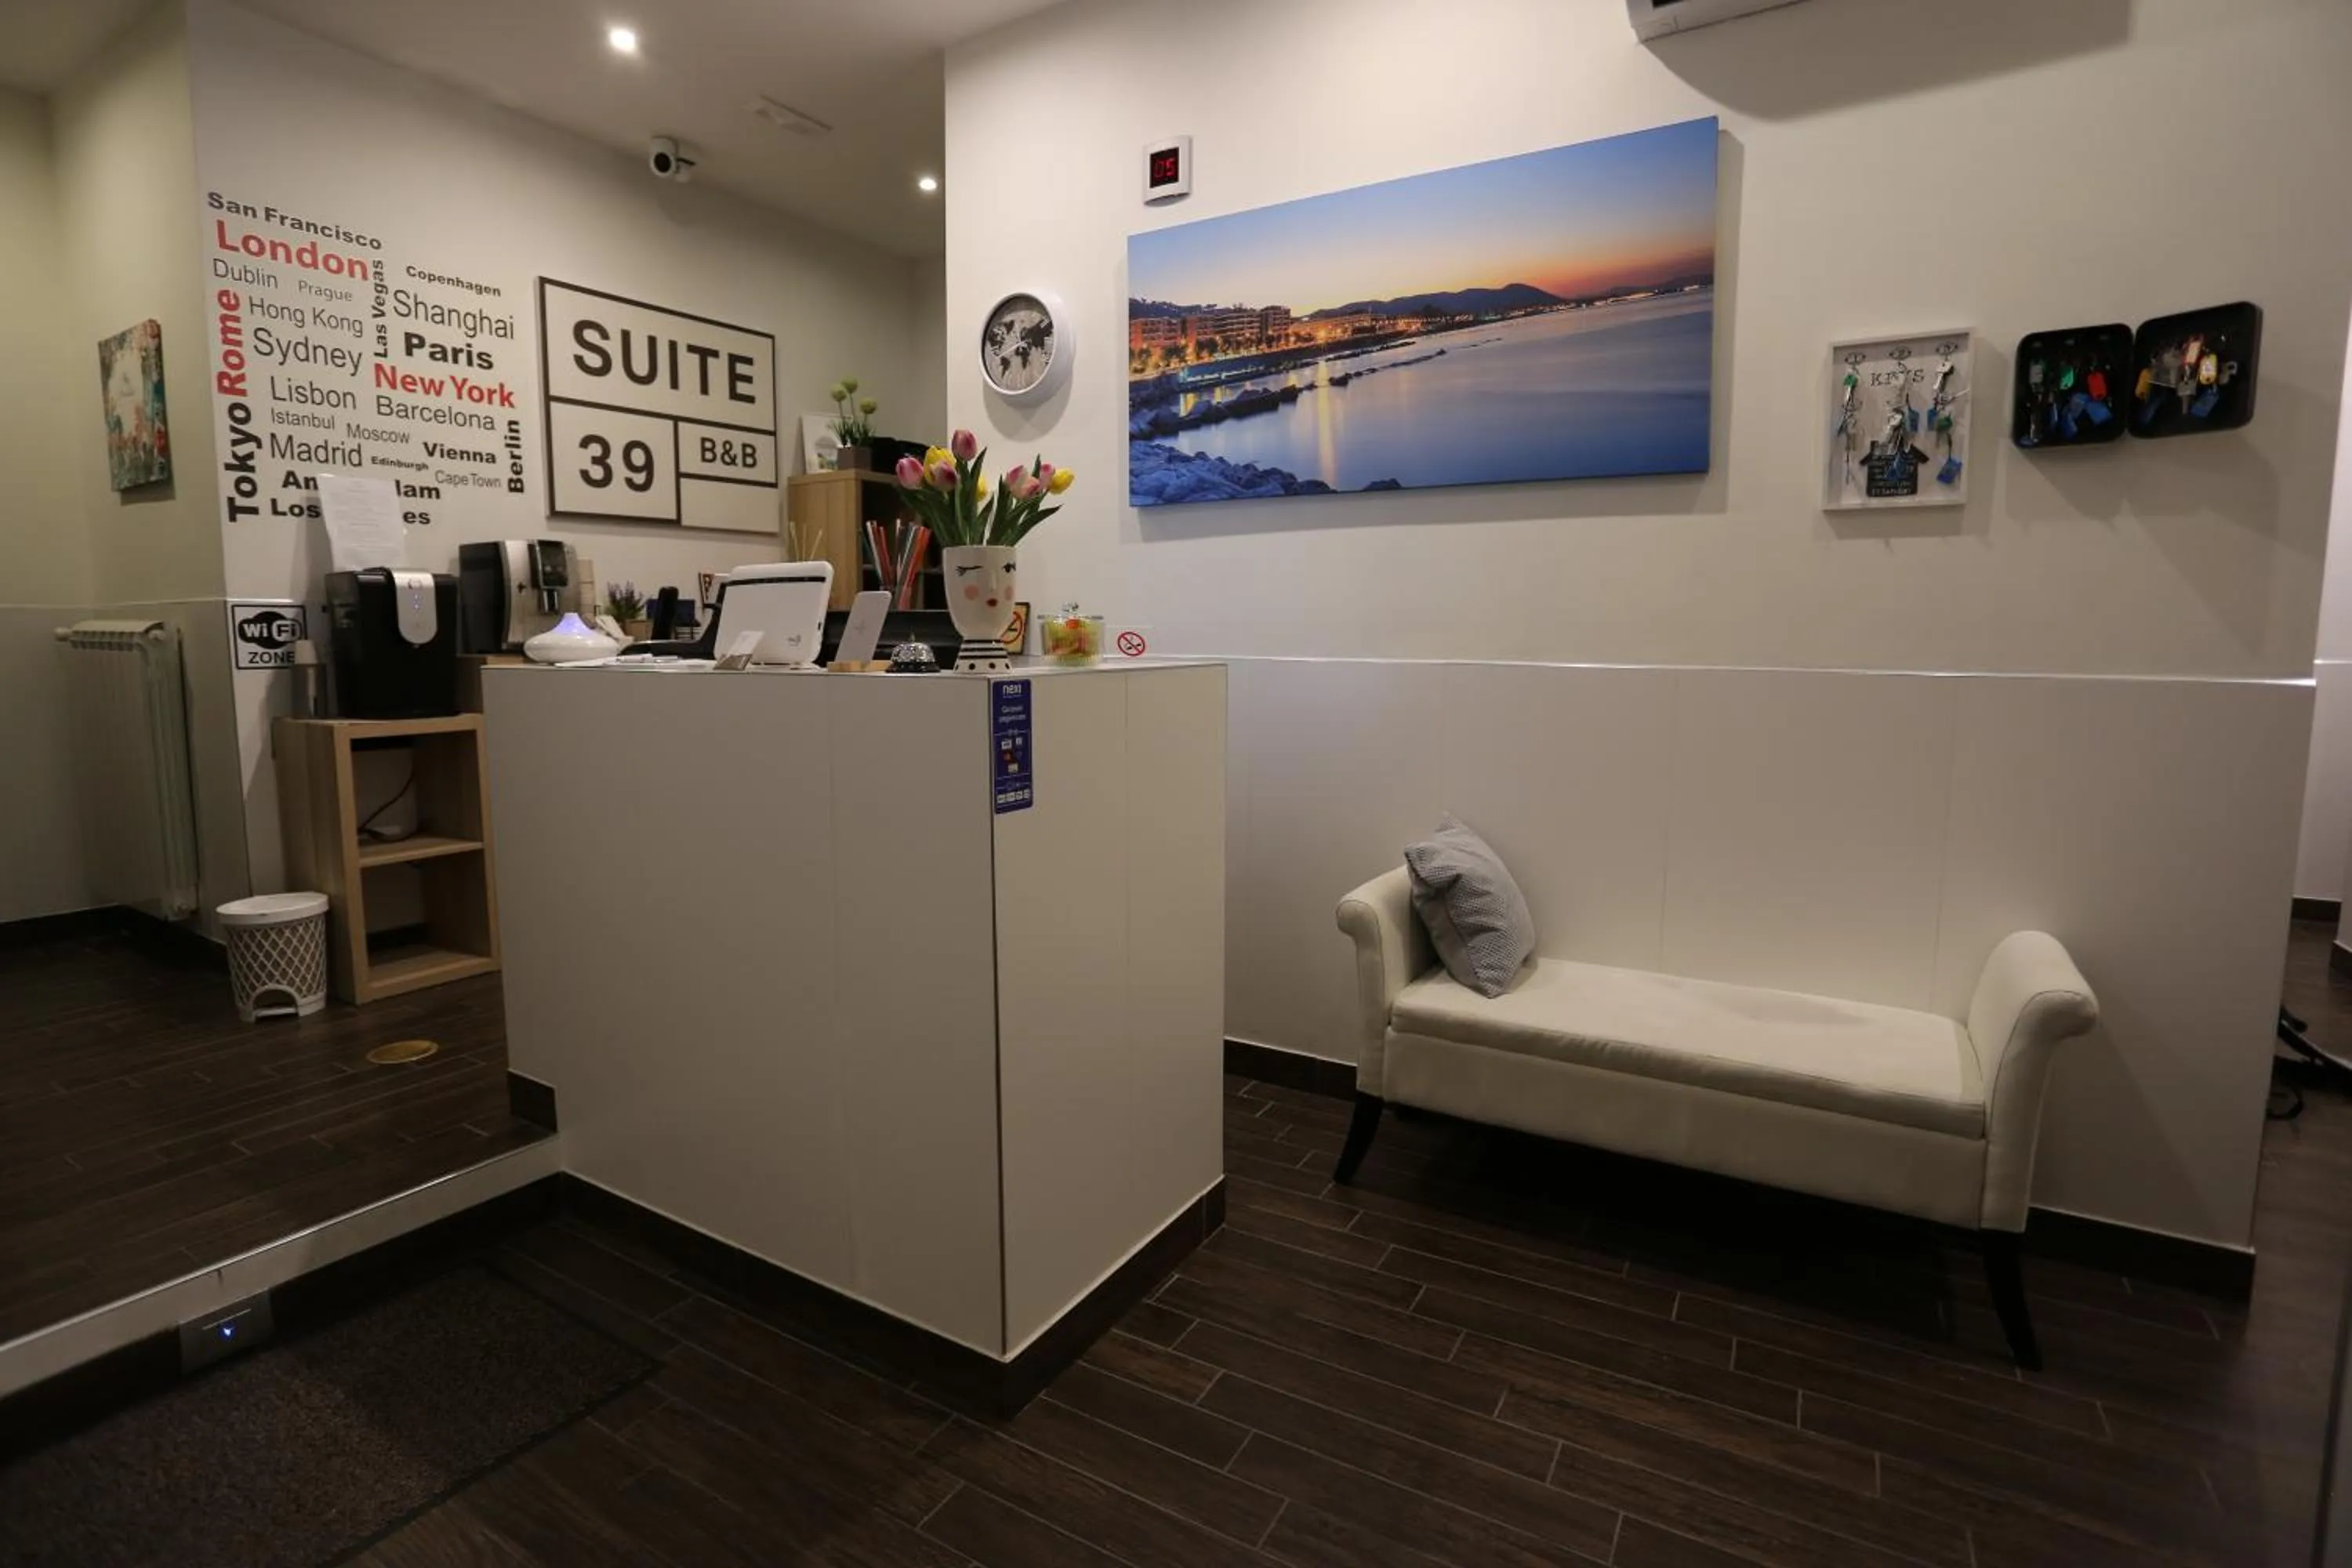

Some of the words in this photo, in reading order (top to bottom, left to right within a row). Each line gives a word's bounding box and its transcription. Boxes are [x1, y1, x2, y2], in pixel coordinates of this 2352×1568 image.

[208, 191, 257, 219] San
[265, 206, 382, 249] Francisco
[216, 220, 369, 281] London
[213, 259, 278, 289] Dublin
[298, 280, 353, 303] Prague
[372, 260, 389, 320] Vegas
[406, 265, 502, 297] Copenhagen
[249, 296, 305, 328] Hong
[313, 307, 363, 337] Kong
[393, 290, 514, 339] Shanghai
[217, 289, 249, 397] Rome
[253, 327, 362, 376] Sydney
[373, 323, 389, 358] Las
[405, 332, 494, 370] Paris
[572, 319, 756, 404] SUITE
[270, 376, 357, 409] Lisbon
[375, 362, 445, 397] New
[450, 376, 515, 408] York
[271, 408, 336, 430] Istanbul
[376, 394, 495, 431] Barcelona
[270, 432, 362, 467] Madrid
[347, 423, 410, 445] Moscow
[224, 402, 262, 523] Tokyo
[371, 456, 430, 471] Edinburgh
[423, 441, 496, 465] Vienna
[504, 419, 524, 493] Berlin
[578, 434, 655, 493] 39
[700, 437, 757, 469] B&B
[434, 470, 468, 488] Cape
[470, 472, 502, 489] Town
[270, 497, 321, 519] Los
[248, 652, 296, 664] ZONE
